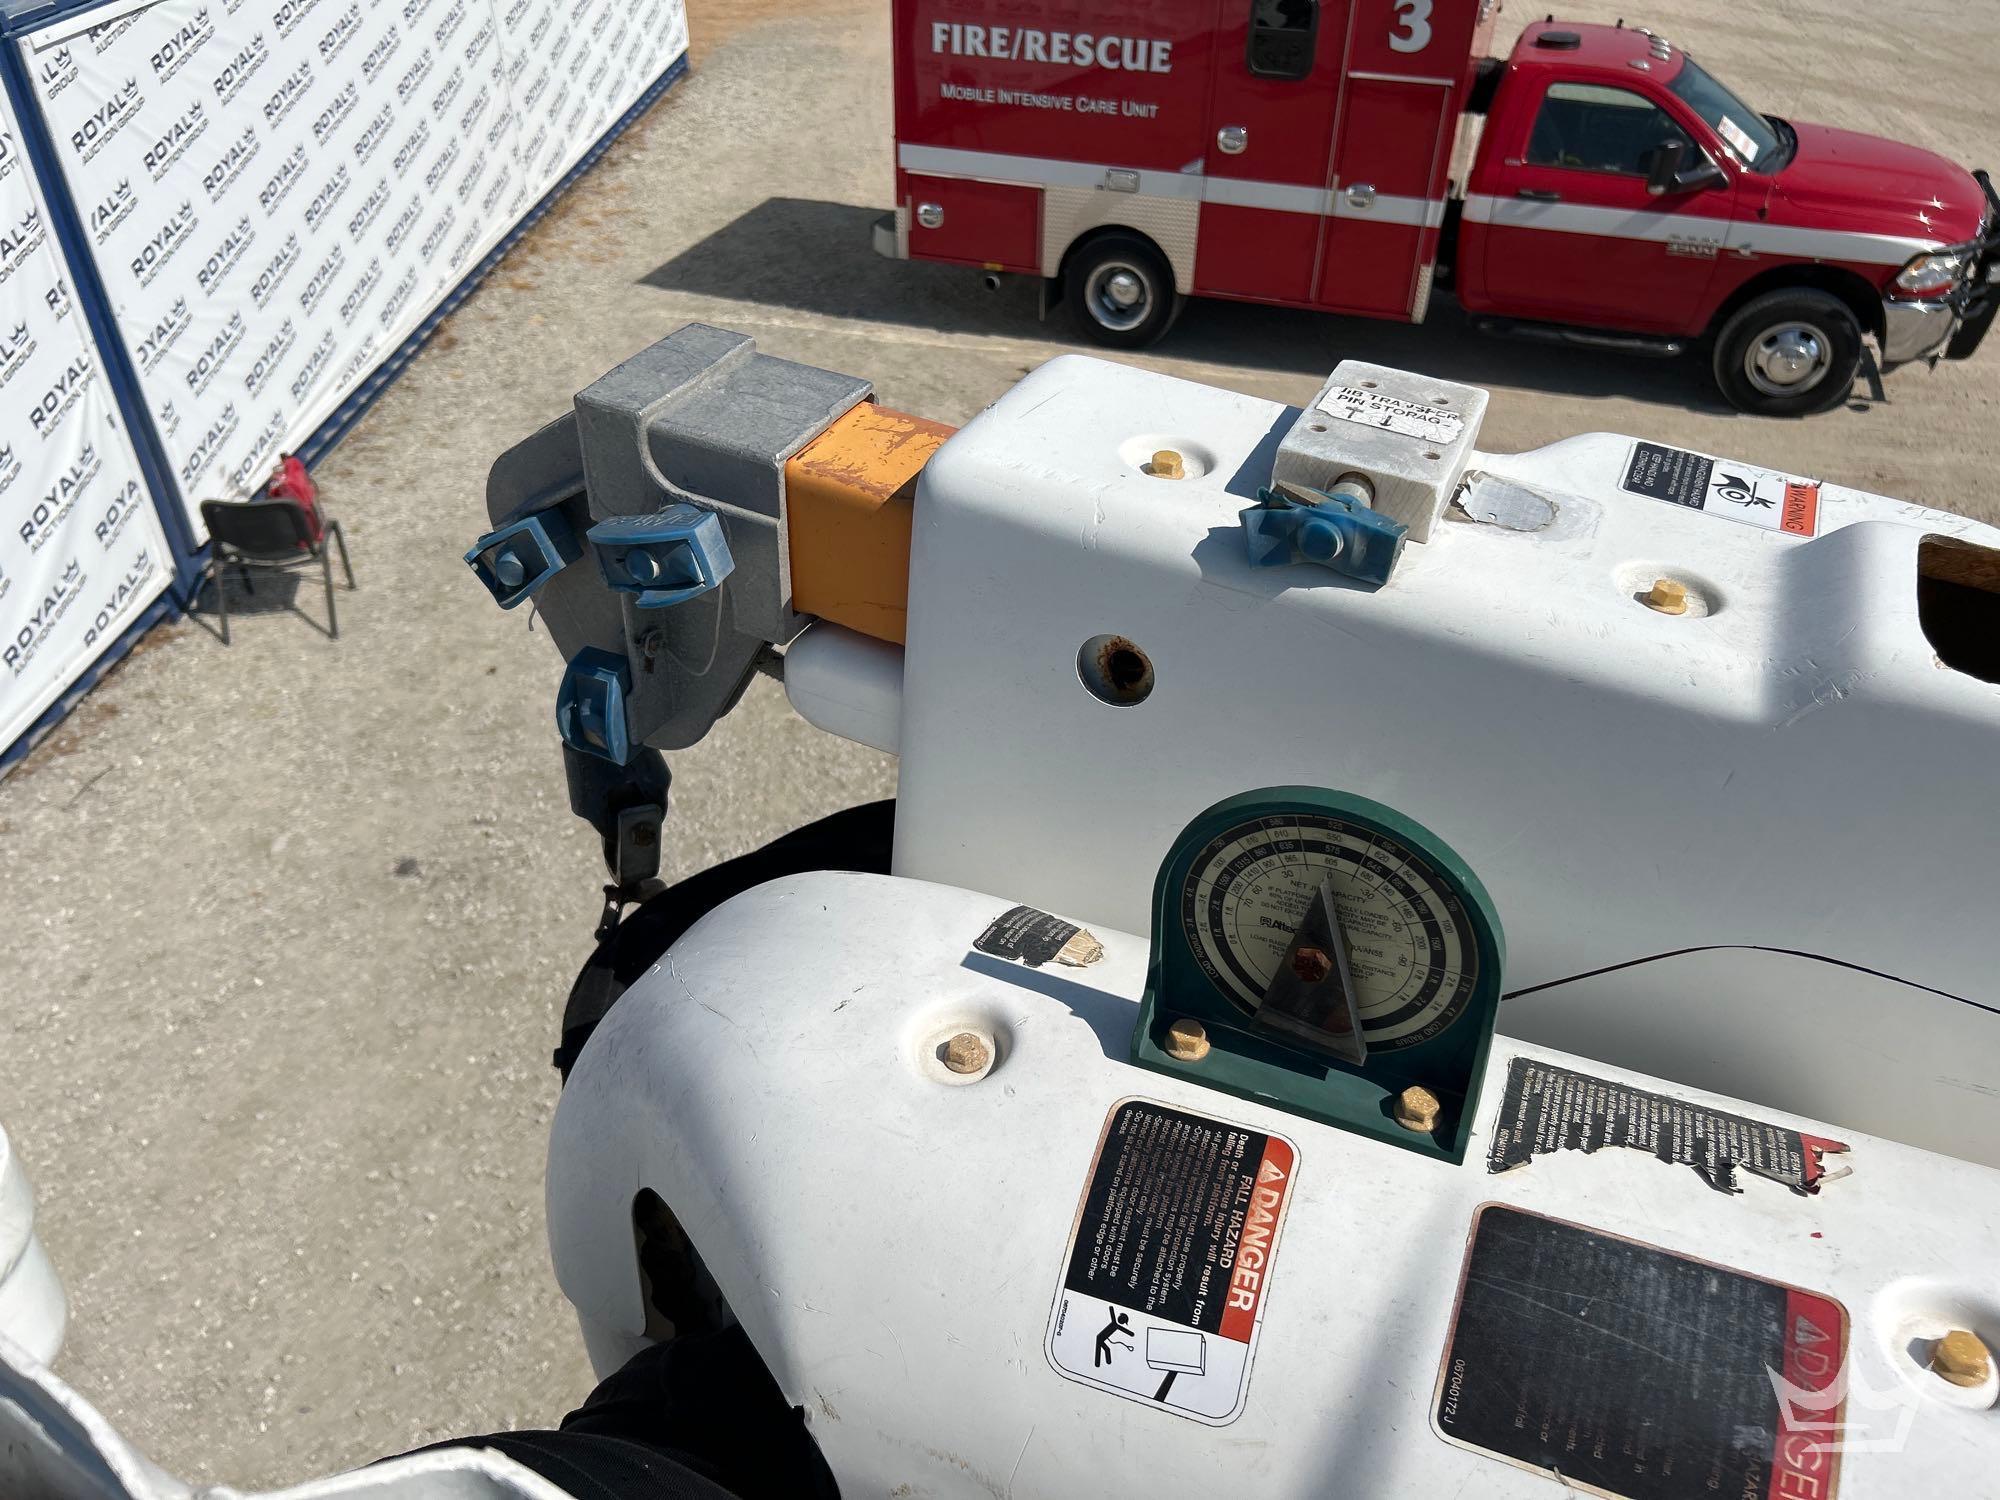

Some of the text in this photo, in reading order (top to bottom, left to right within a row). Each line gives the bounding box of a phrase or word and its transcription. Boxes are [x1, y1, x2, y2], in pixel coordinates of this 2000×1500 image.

[150, 22, 200, 73] ROYAL
[932, 21, 1173, 73] FIRE/RESCUE
[1389, 0, 1432, 53] 3
[213, 46, 256, 97] ROYAL
[263, 73, 302, 120] ROYAL
[312, 93, 349, 138] ROYAL
[72, 94, 127, 153] ROYAL
[143, 116, 193, 172] ROYAL
[202, 140, 247, 193] ROYAL
[259, 157, 297, 208] ROYAL
[305, 177, 340, 224] ROYAL
[130, 218, 183, 278] ROYAL
[196, 231, 242, 287] ROYAL
[251, 248, 290, 301] ROYAL
[300, 258, 335, 307] ROYAL
[137, 316, 176, 364] OYAL
[186, 328, 233, 388] ROYAL
[245, 334, 285, 390] ROYAL
[30, 357, 90, 430] ROYAL
[291, 344, 326, 397] ROYAL
[1337, 394, 1451, 428] PIN STORAG
[234, 427, 274, 484] ROYAL
[19, 467, 83, 544] ROYAL
[95, 480, 139, 542] ROYA
[1785, 487, 1806, 531] WARNING
[3, 585, 67, 668] ROYAL
[84, 573, 138, 647] ROYAL
[1220, 1131, 1237, 1156] falling
[1233, 1133, 1248, 1159] Death
[1215, 1158, 1230, 1180] from
[1219, 1173, 1236, 1209] serious
[1100, 1187, 1119, 1222] platform
[1109, 1185, 1130, 1225] equipped
[1127, 1186, 1140, 1206] door
[1093, 1222, 1108, 1245] edge
[1106, 1224, 1119, 1243] with
[1118, 1207, 1135, 1242] restraint
[1141, 1216, 1154, 1238] must
[1186, 1214, 1199, 1235] must
[1209, 1211, 1227, 1241] injury
[1217, 1174, 1253, 1269] FALL HAZARD
[1086, 1257, 1100, 1281] other
[1112, 1242, 1125, 1264] must
[1126, 1251, 1145, 1289] securely
[1150, 1246, 1168, 1284] attached
[1163, 1227, 1184, 1271] protection
[1170, 1253, 1189, 1290] properly
[1206, 1243, 1219, 1262] will
[1227, 1186, 1280, 1312] DANGER
[1145, 1296, 1156, 1311] the
[1197, 1264, 1214, 1296] result
[1190, 1299, 1206, 1326] from
[1445, 1359, 1465, 1416] 067040172
